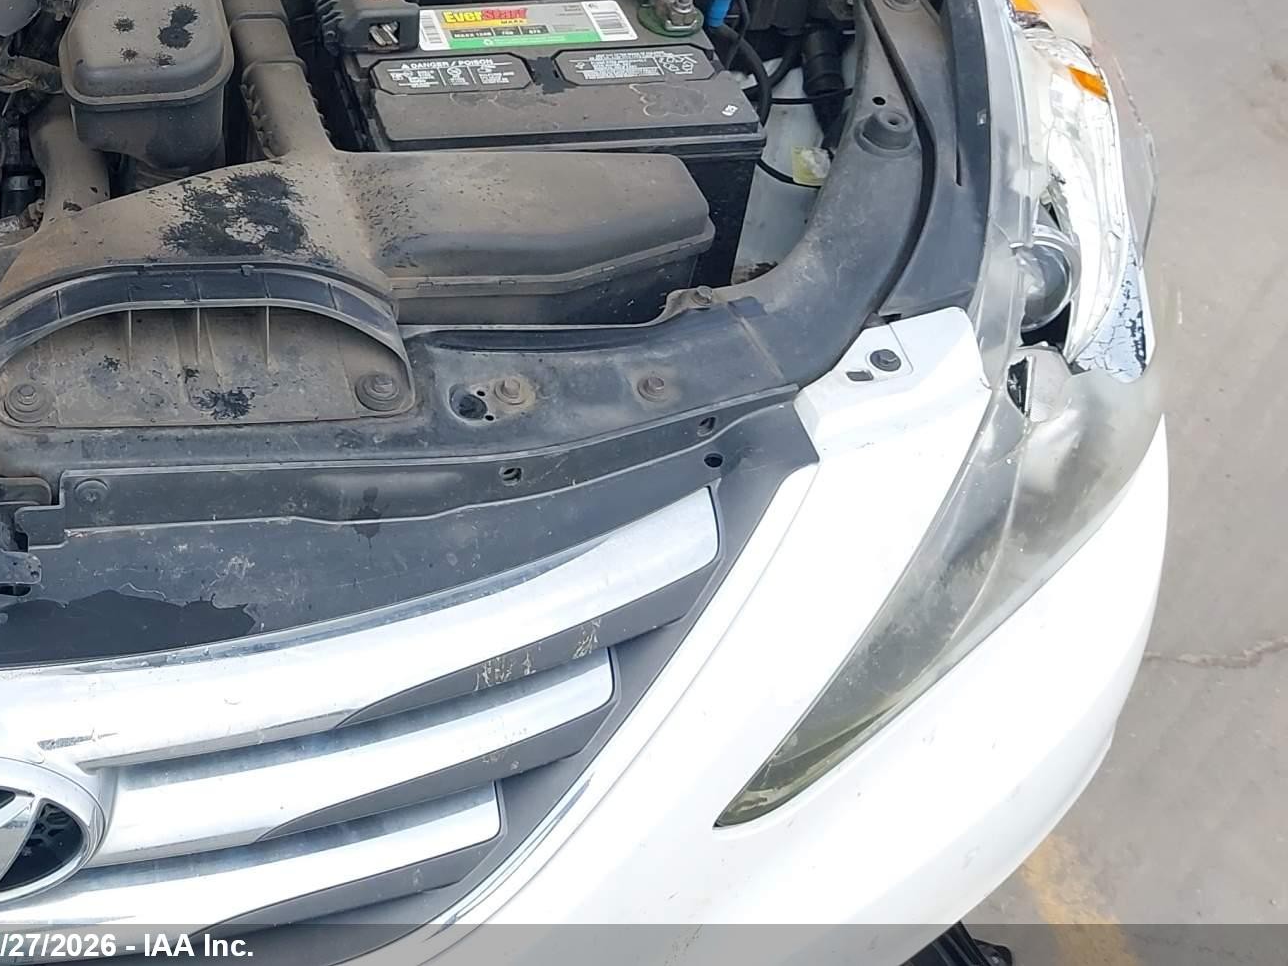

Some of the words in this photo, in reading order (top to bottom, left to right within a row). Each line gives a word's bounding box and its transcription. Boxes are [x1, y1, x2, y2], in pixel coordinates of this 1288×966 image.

[443, 8, 527, 23] EverStart
[410, 61, 449, 70] DANGER
[457, 58, 495, 67] POISON
